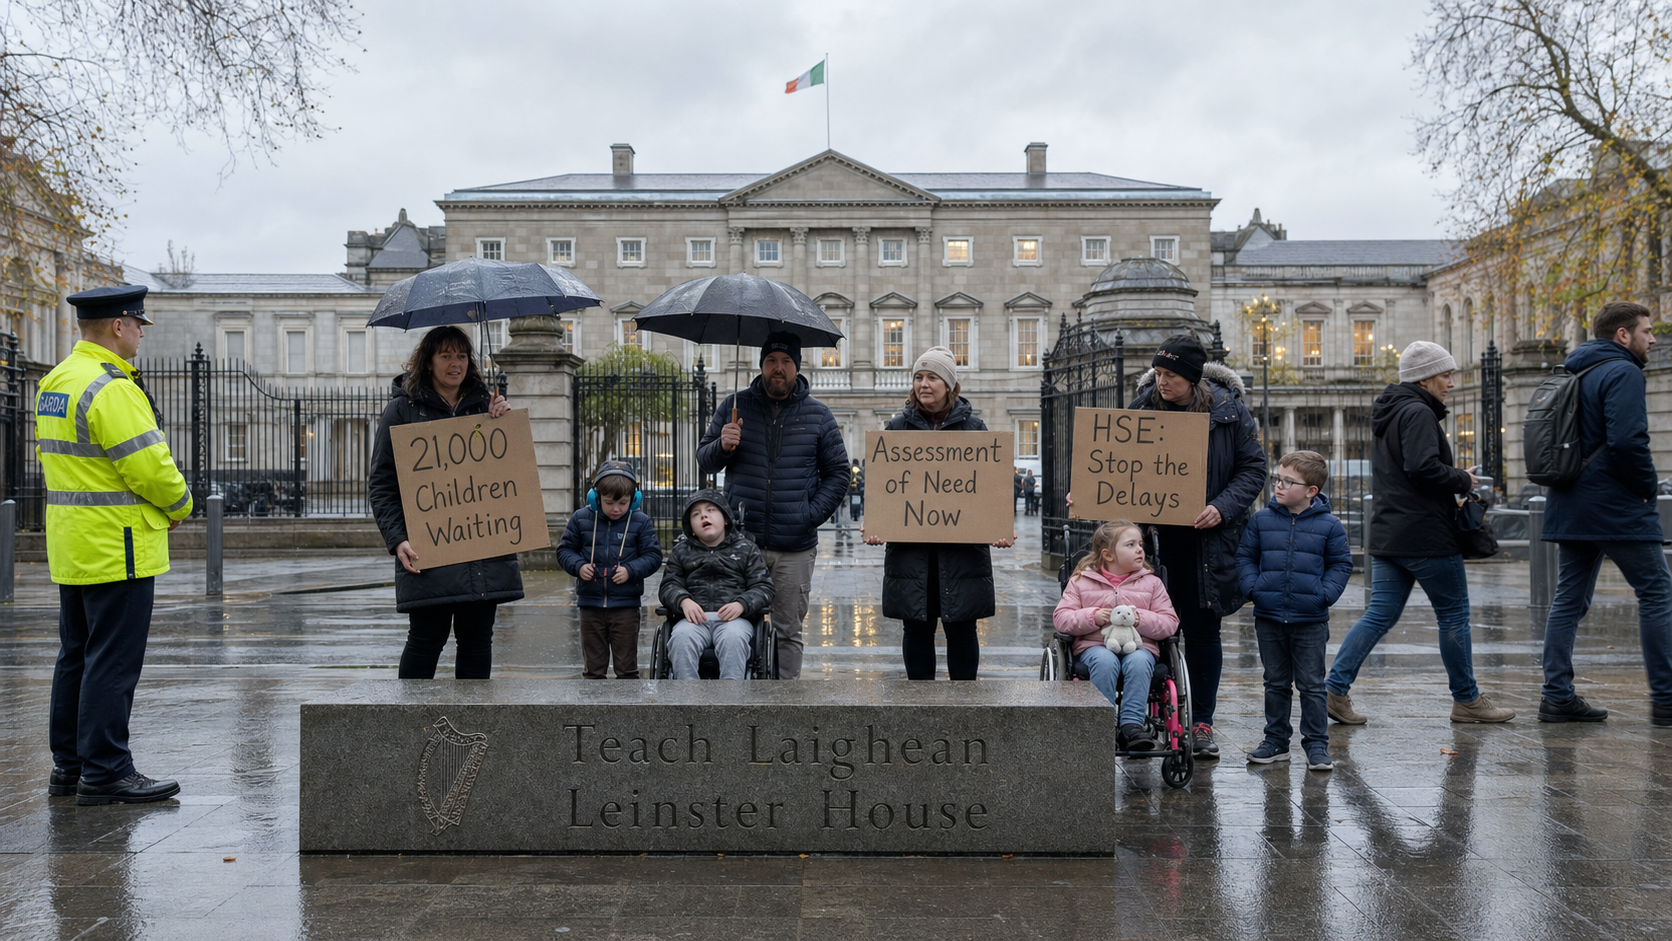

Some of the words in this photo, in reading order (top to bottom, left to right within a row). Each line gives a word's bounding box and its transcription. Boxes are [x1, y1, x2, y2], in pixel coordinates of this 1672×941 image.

[1093, 414, 1165, 444] HSE:
[410, 428, 507, 472] 21,000
[872, 436, 1002, 463] Assessment
[1088, 449, 1143, 482] Stop
[1153, 453, 1189, 476] the
[416, 475, 518, 512] Children
[885, 470, 911, 494] of
[924, 470, 977, 494] Need
[1097, 481, 1180, 517] Delays
[425, 513, 522, 547] Waiting
[904, 500, 961, 527] Now
[563, 724, 714, 765] Teach
[747, 724, 989, 780] Laighean
[567, 788, 784, 829] Leinster
[821, 789, 989, 830] House
